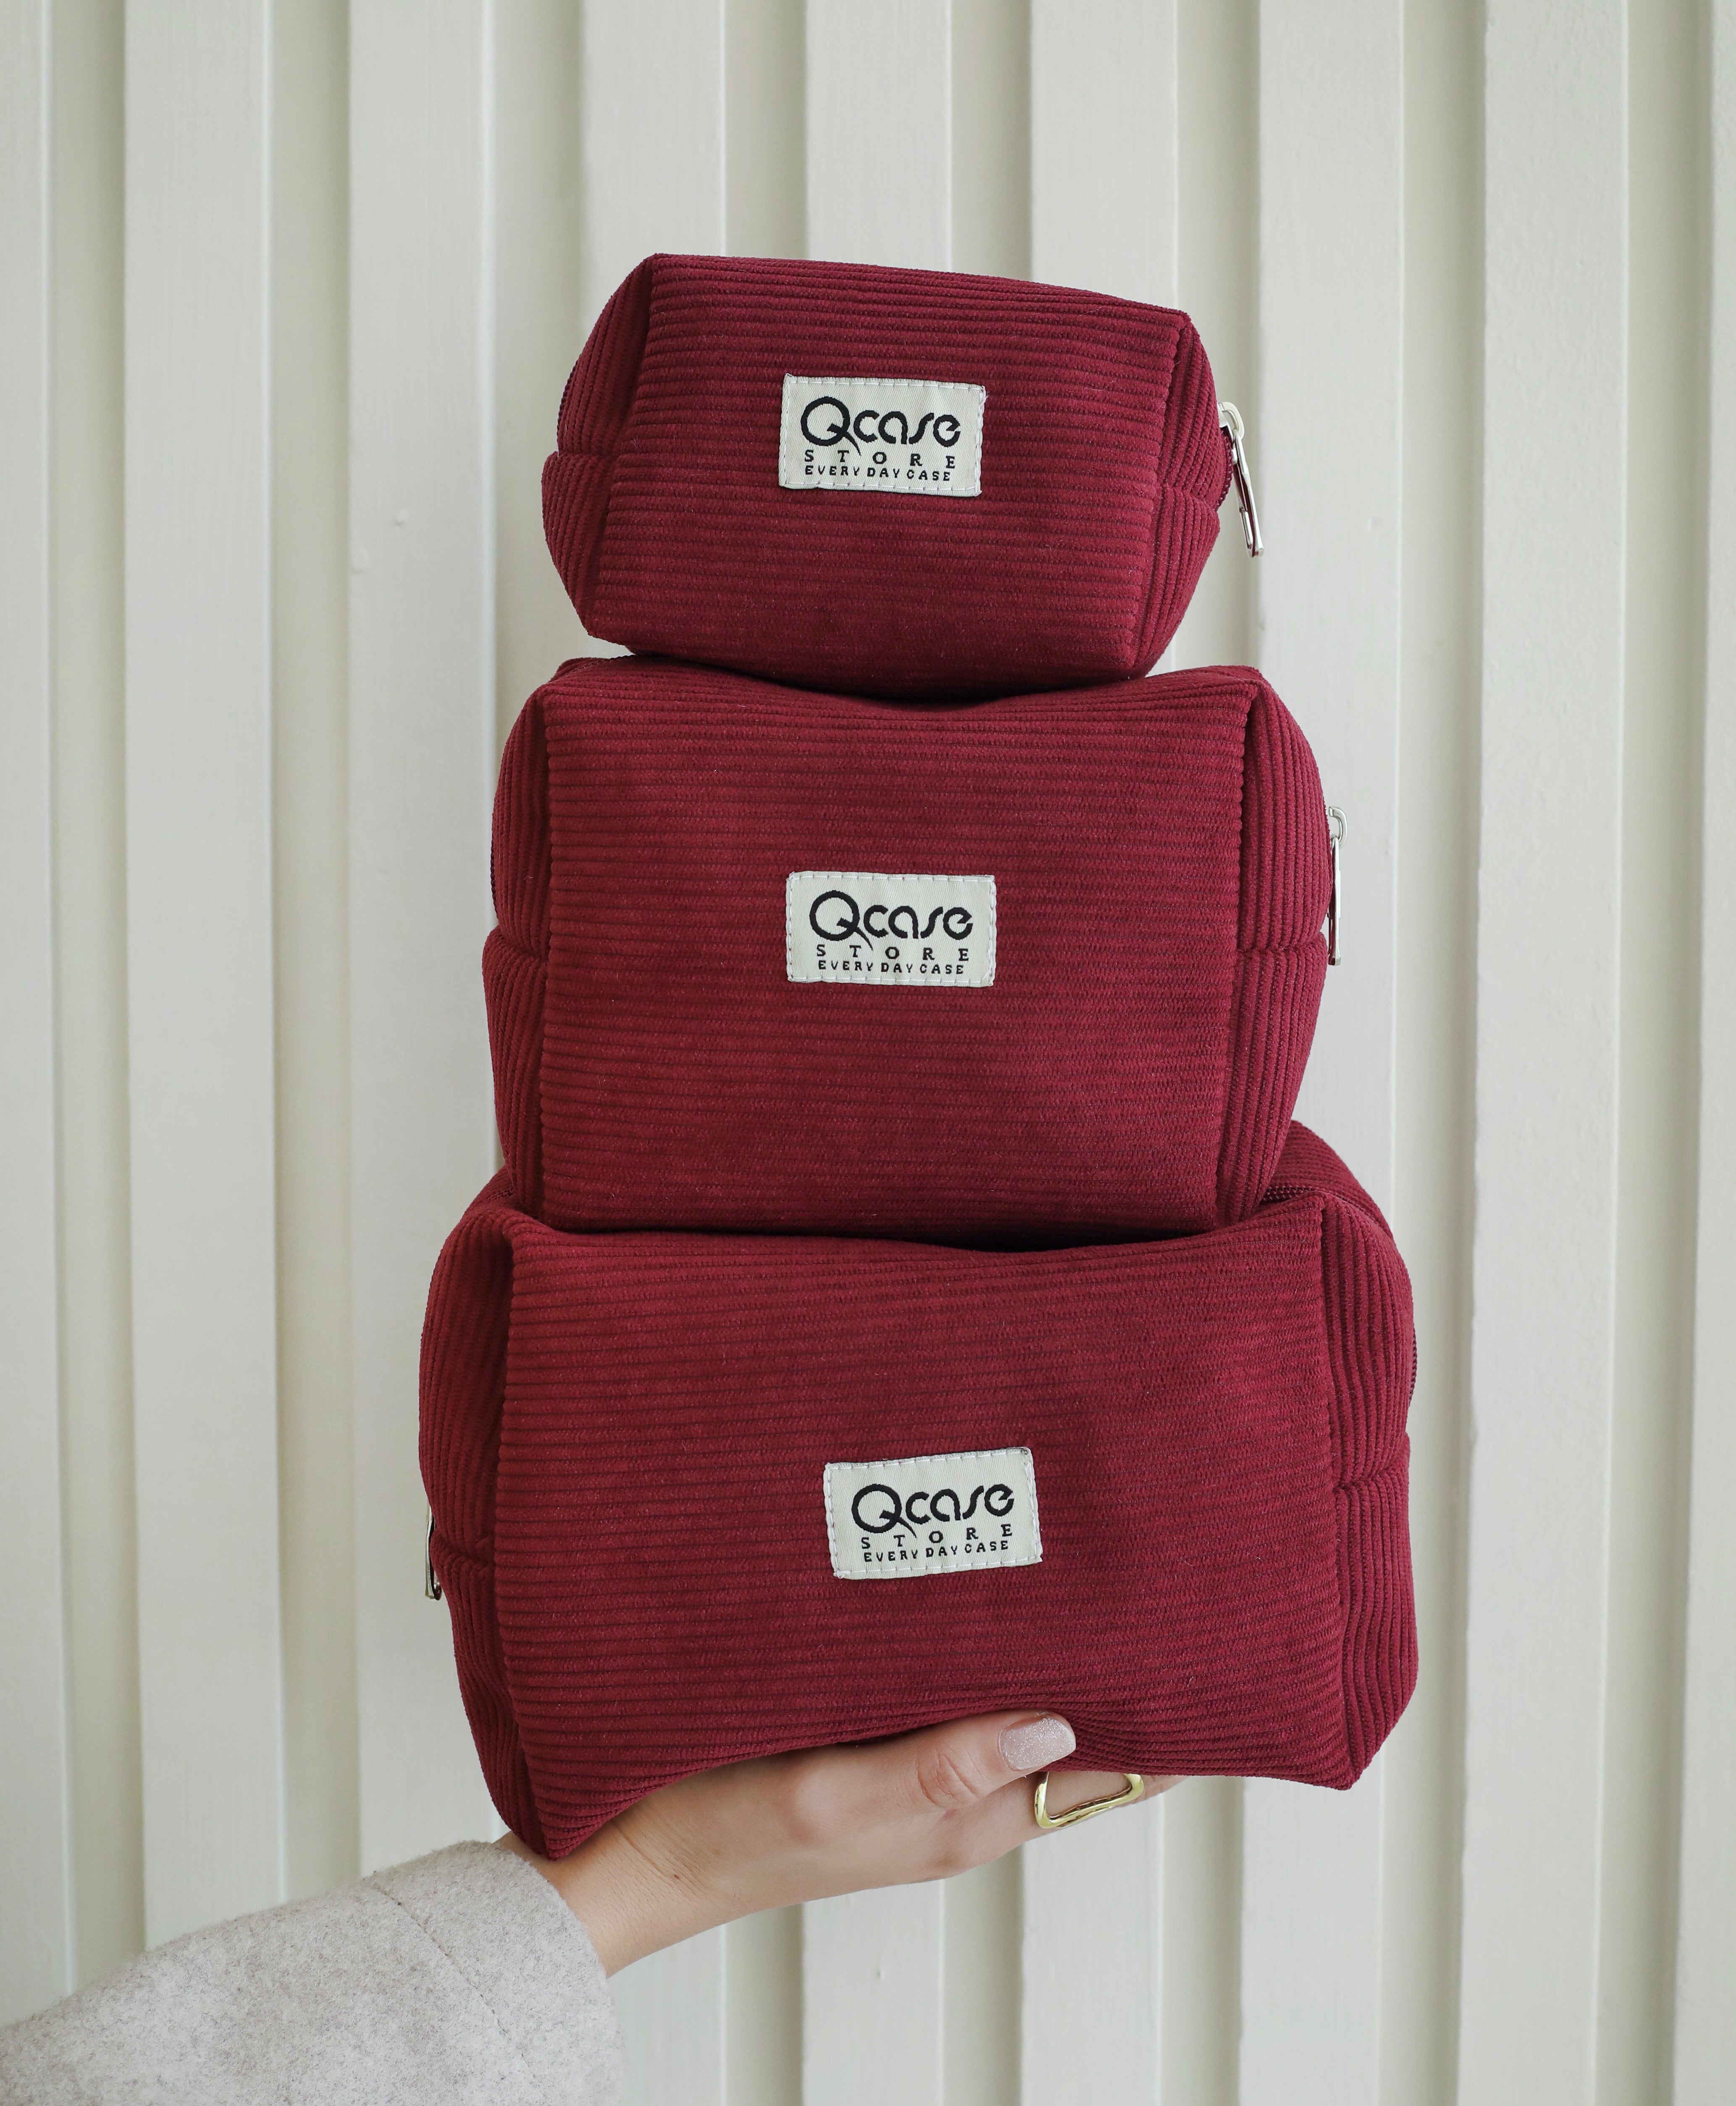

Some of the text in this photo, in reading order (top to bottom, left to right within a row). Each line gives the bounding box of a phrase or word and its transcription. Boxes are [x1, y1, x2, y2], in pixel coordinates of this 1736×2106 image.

[803, 449, 956, 469] STORE
[816, 943, 970, 962] STORE
[860, 1523, 1013, 1550] STORE
